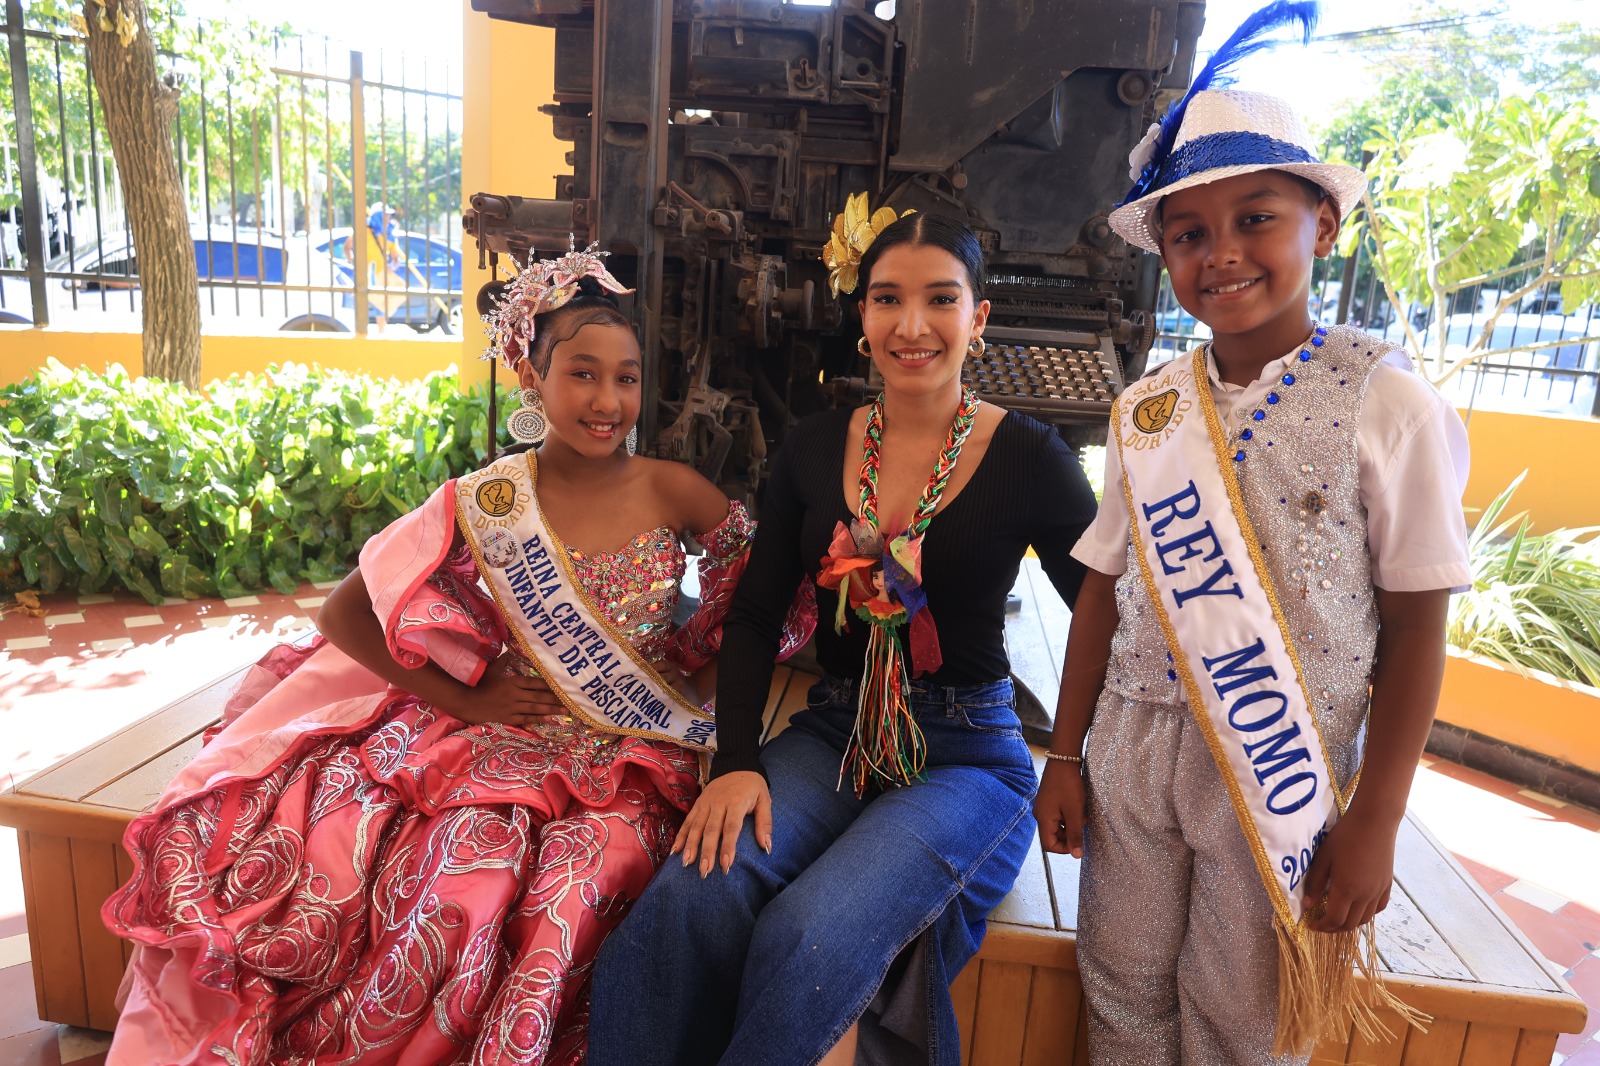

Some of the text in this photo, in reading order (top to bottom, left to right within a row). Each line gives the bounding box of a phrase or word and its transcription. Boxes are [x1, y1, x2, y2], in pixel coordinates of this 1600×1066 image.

[459, 464, 525, 498] PESCAITO
[1123, 400, 1192, 451] DORADO
[505, 560, 564, 647] INFANTIL
[558, 645, 590, 677] DE
[522, 534, 673, 729] REINA CENTRAL CARNAVAL
[1142, 479, 1318, 815] REY MOMO
